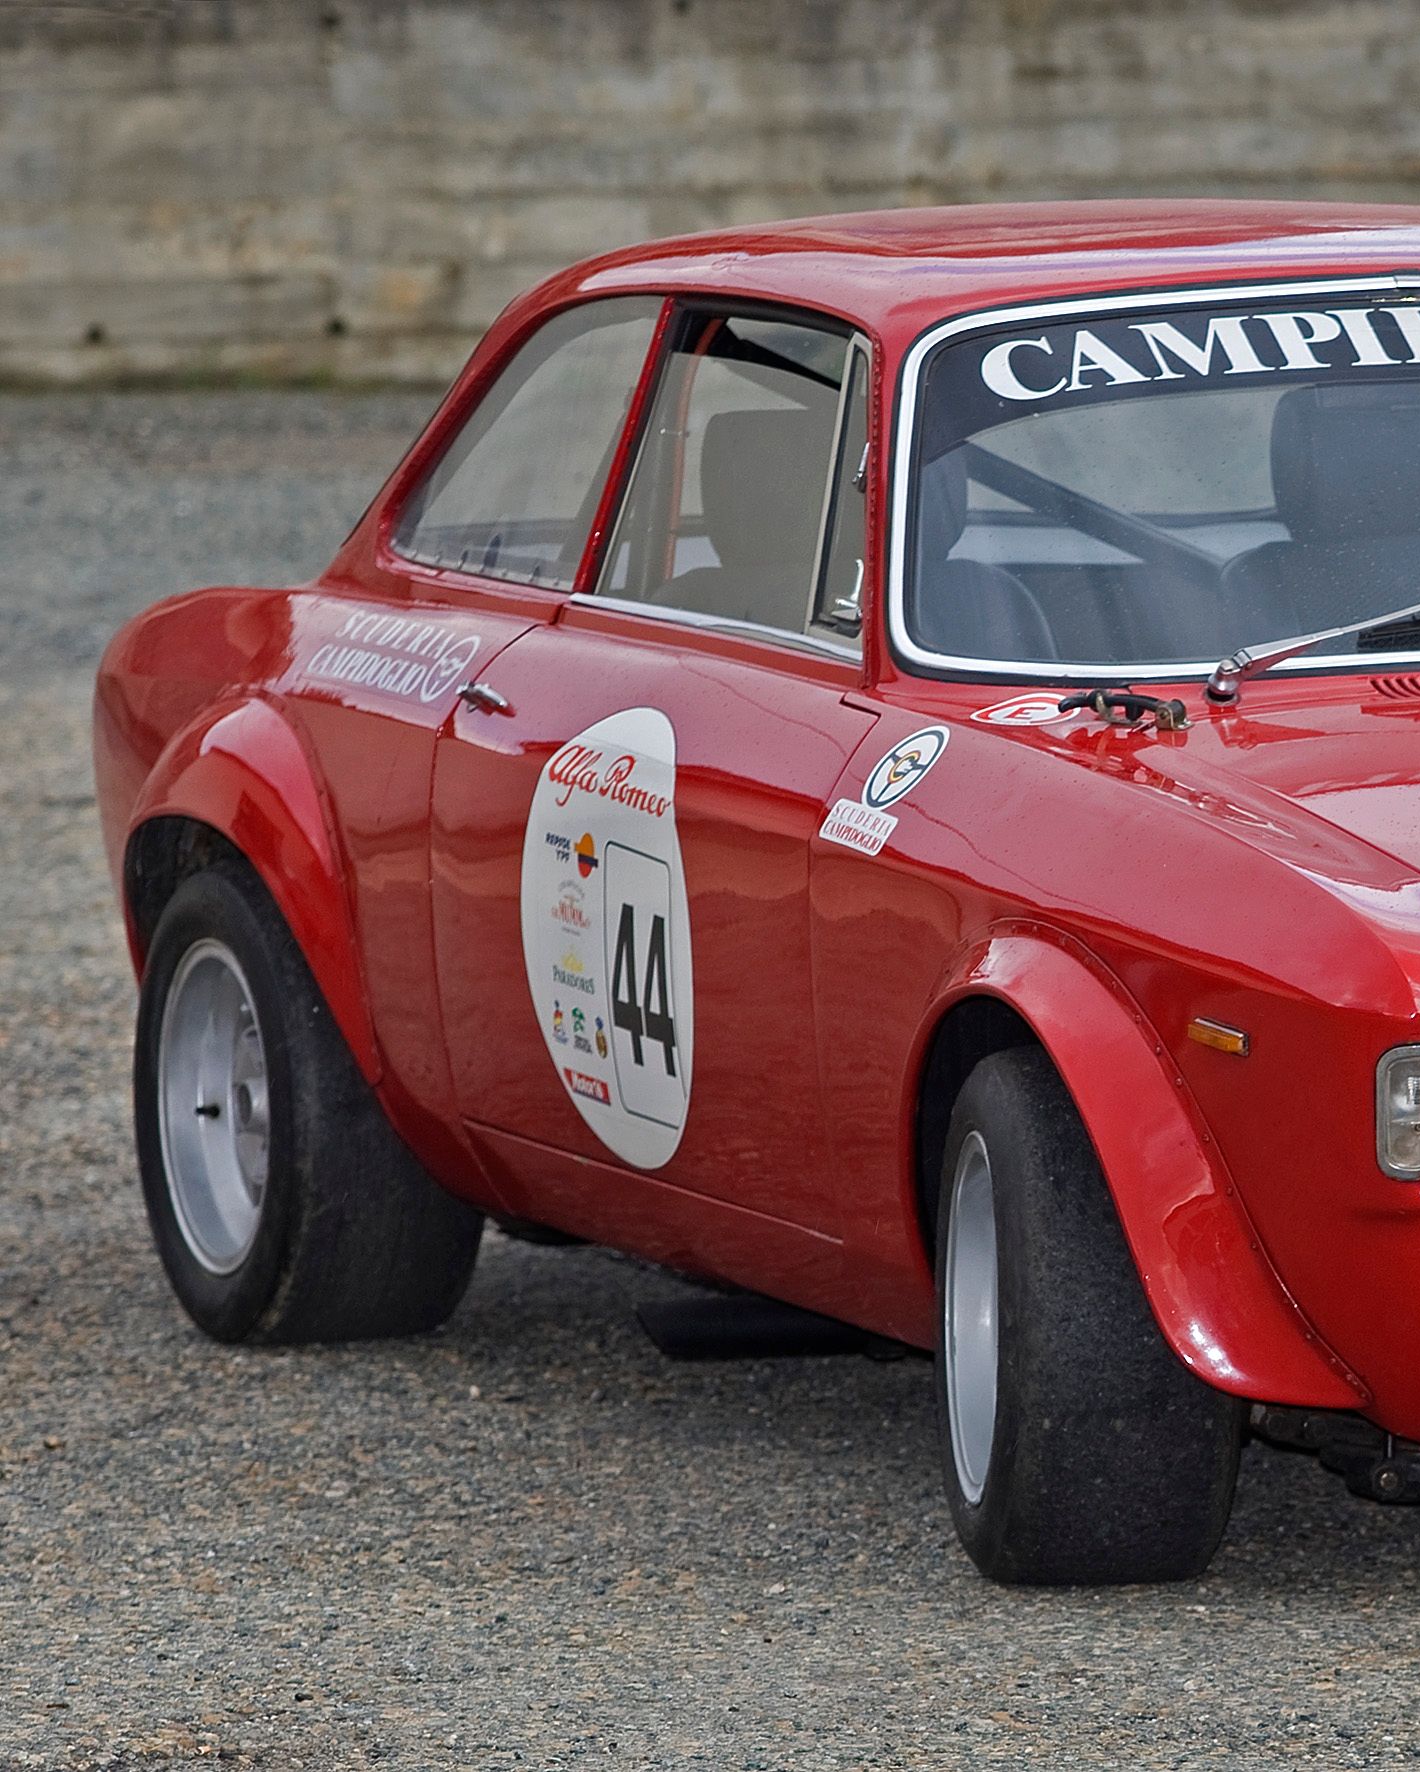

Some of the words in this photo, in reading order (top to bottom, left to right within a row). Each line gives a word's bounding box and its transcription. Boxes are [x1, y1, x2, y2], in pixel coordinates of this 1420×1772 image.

[335, 610, 455, 660] SCUDERIA
[307, 643, 428, 696] CAMPIDOGLIO
[1003, 706, 1048, 720] E
[548, 744, 598, 808] Alfa
[599, 755, 672, 818] Romeo
[823, 820, 882, 852] CAMPIDOGLIO
[831, 804, 892, 837] SCUDERIA
[612, 903, 677, 1078] 44
